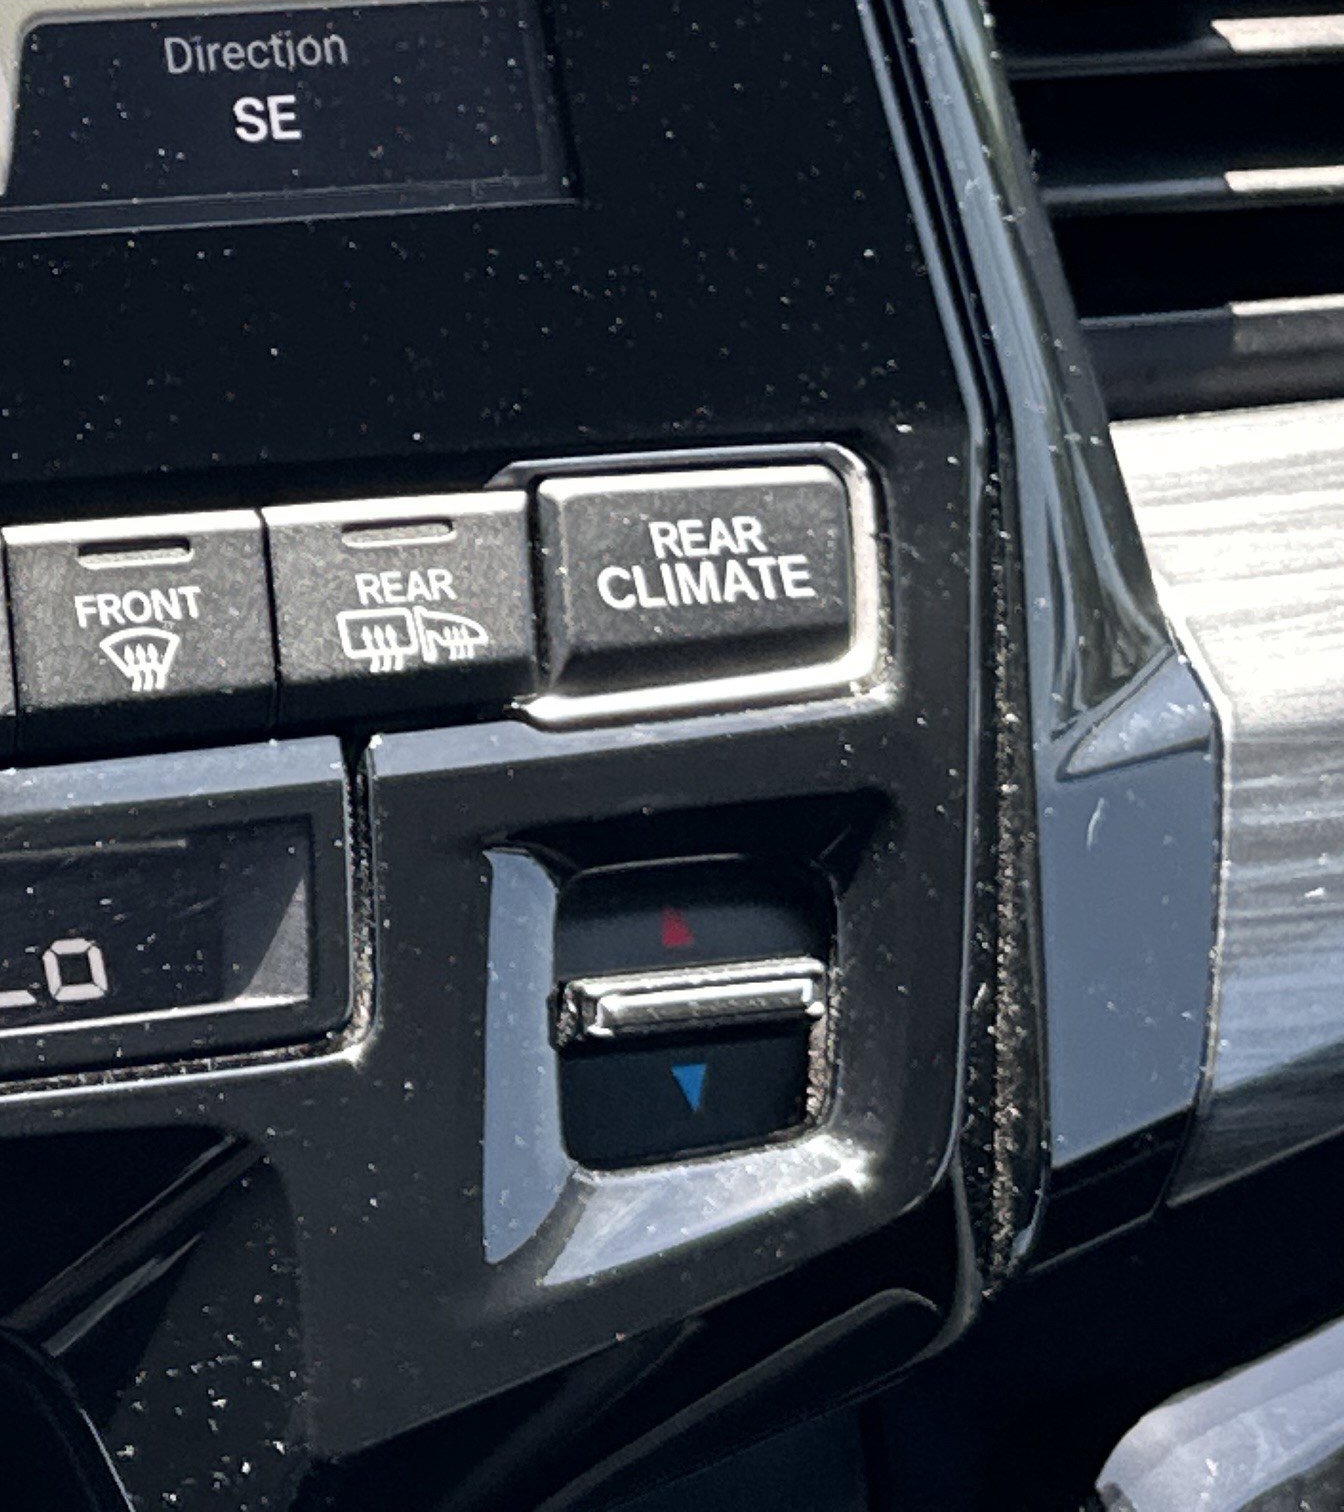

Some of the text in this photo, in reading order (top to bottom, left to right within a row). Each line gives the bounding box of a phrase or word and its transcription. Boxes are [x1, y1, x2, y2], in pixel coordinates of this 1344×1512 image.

[164, 33, 349, 74] Direction
[232, 95, 302, 143] SE
[649, 516, 768, 558] REAR
[355, 569, 459, 604] REAR
[596, 553, 816, 611] CLIMATE
[74, 585, 203, 627] FRONT
